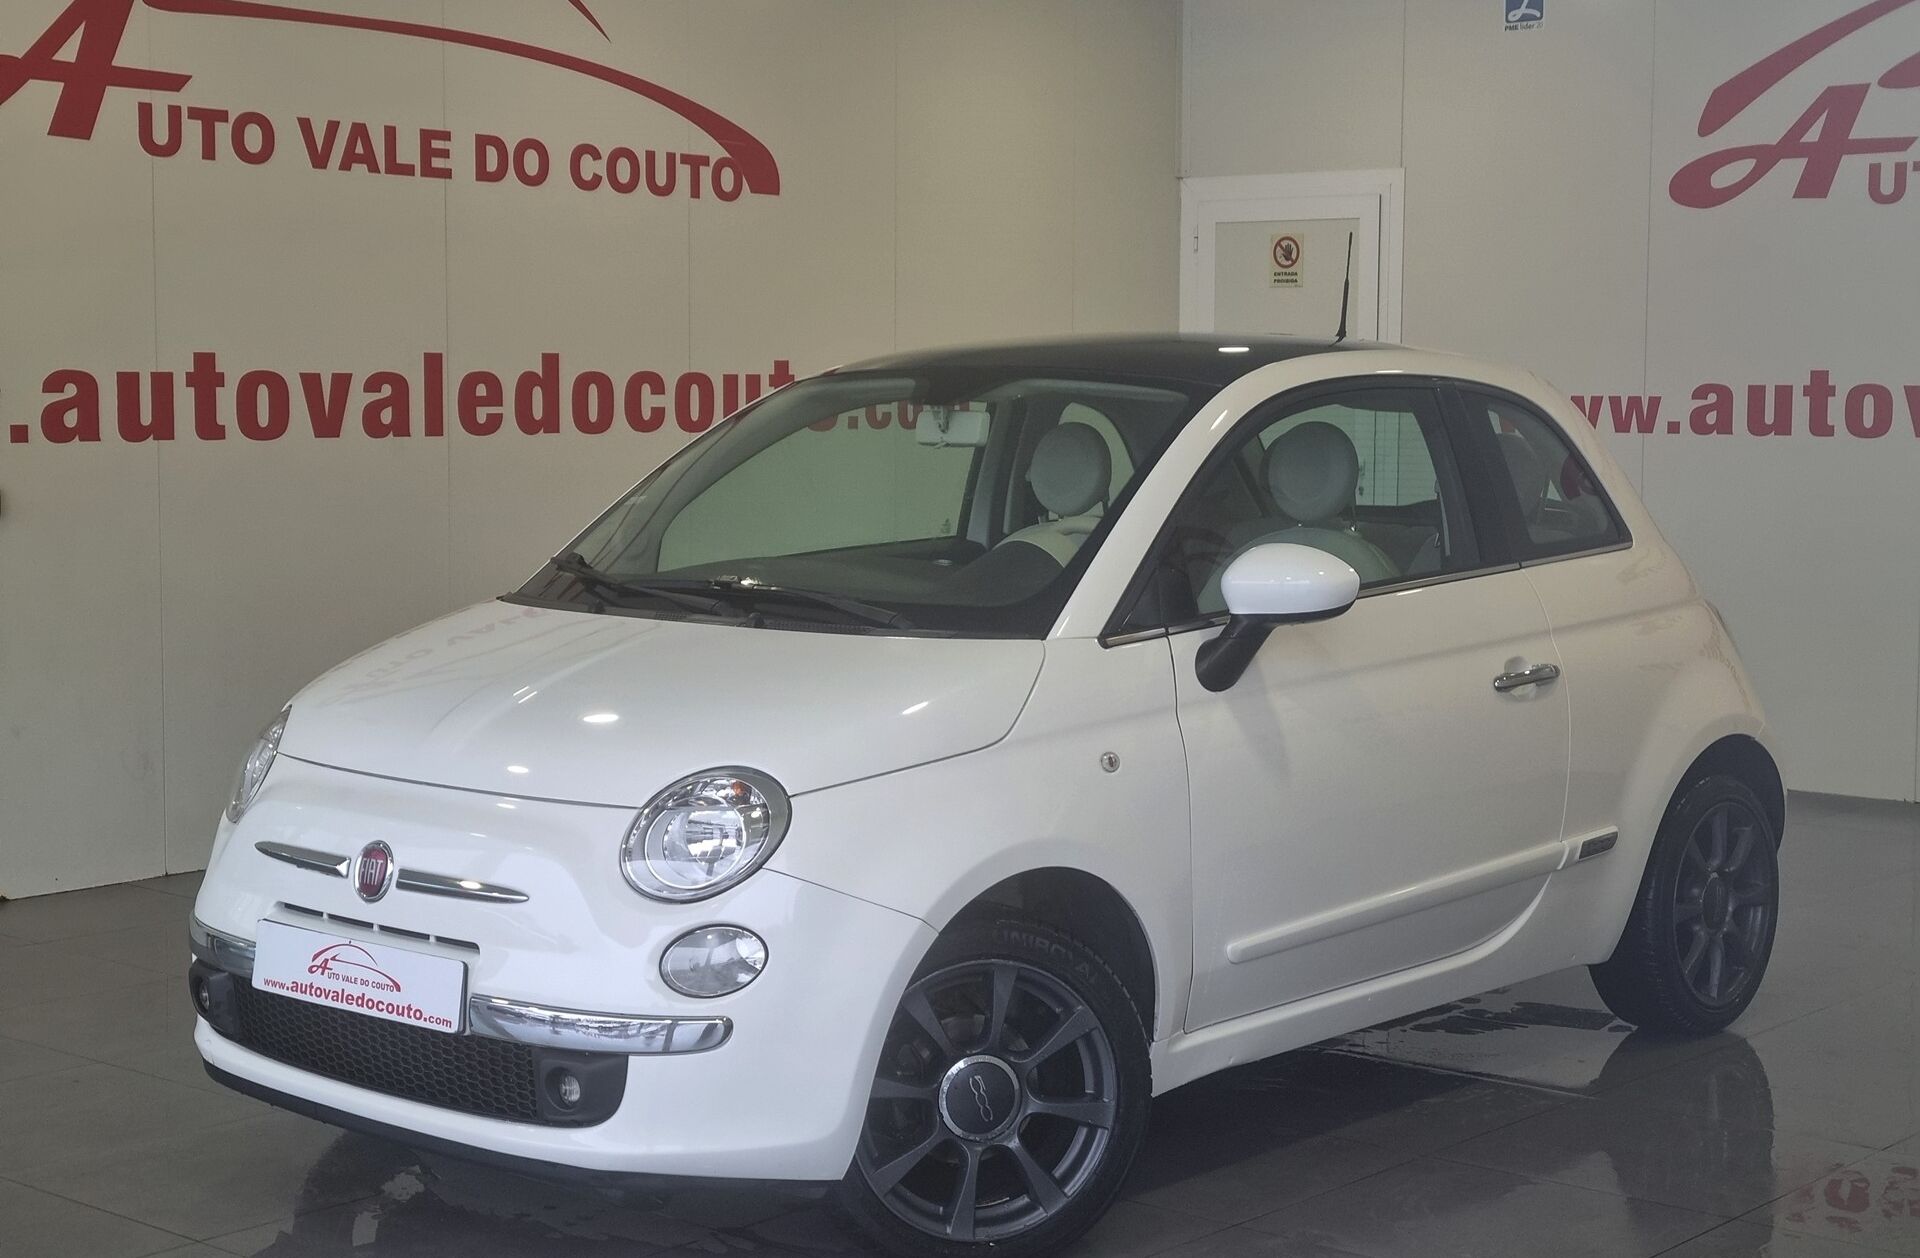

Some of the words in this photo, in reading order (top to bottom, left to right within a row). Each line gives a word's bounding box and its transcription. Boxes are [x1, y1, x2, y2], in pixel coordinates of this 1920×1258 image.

[296, 116, 453, 180] VALE
[475, 134, 551, 187] DO
[569, 143, 744, 202] COUTO
[359, 857, 384, 886] FIAT
[308, 958, 340, 981] AUTO
[341, 974, 359, 985] VALE
[360, 978, 370, 987] DO
[371, 980, 395, 992] COUTO
[263, 977, 453, 1029] www.autovaledocouto.com
